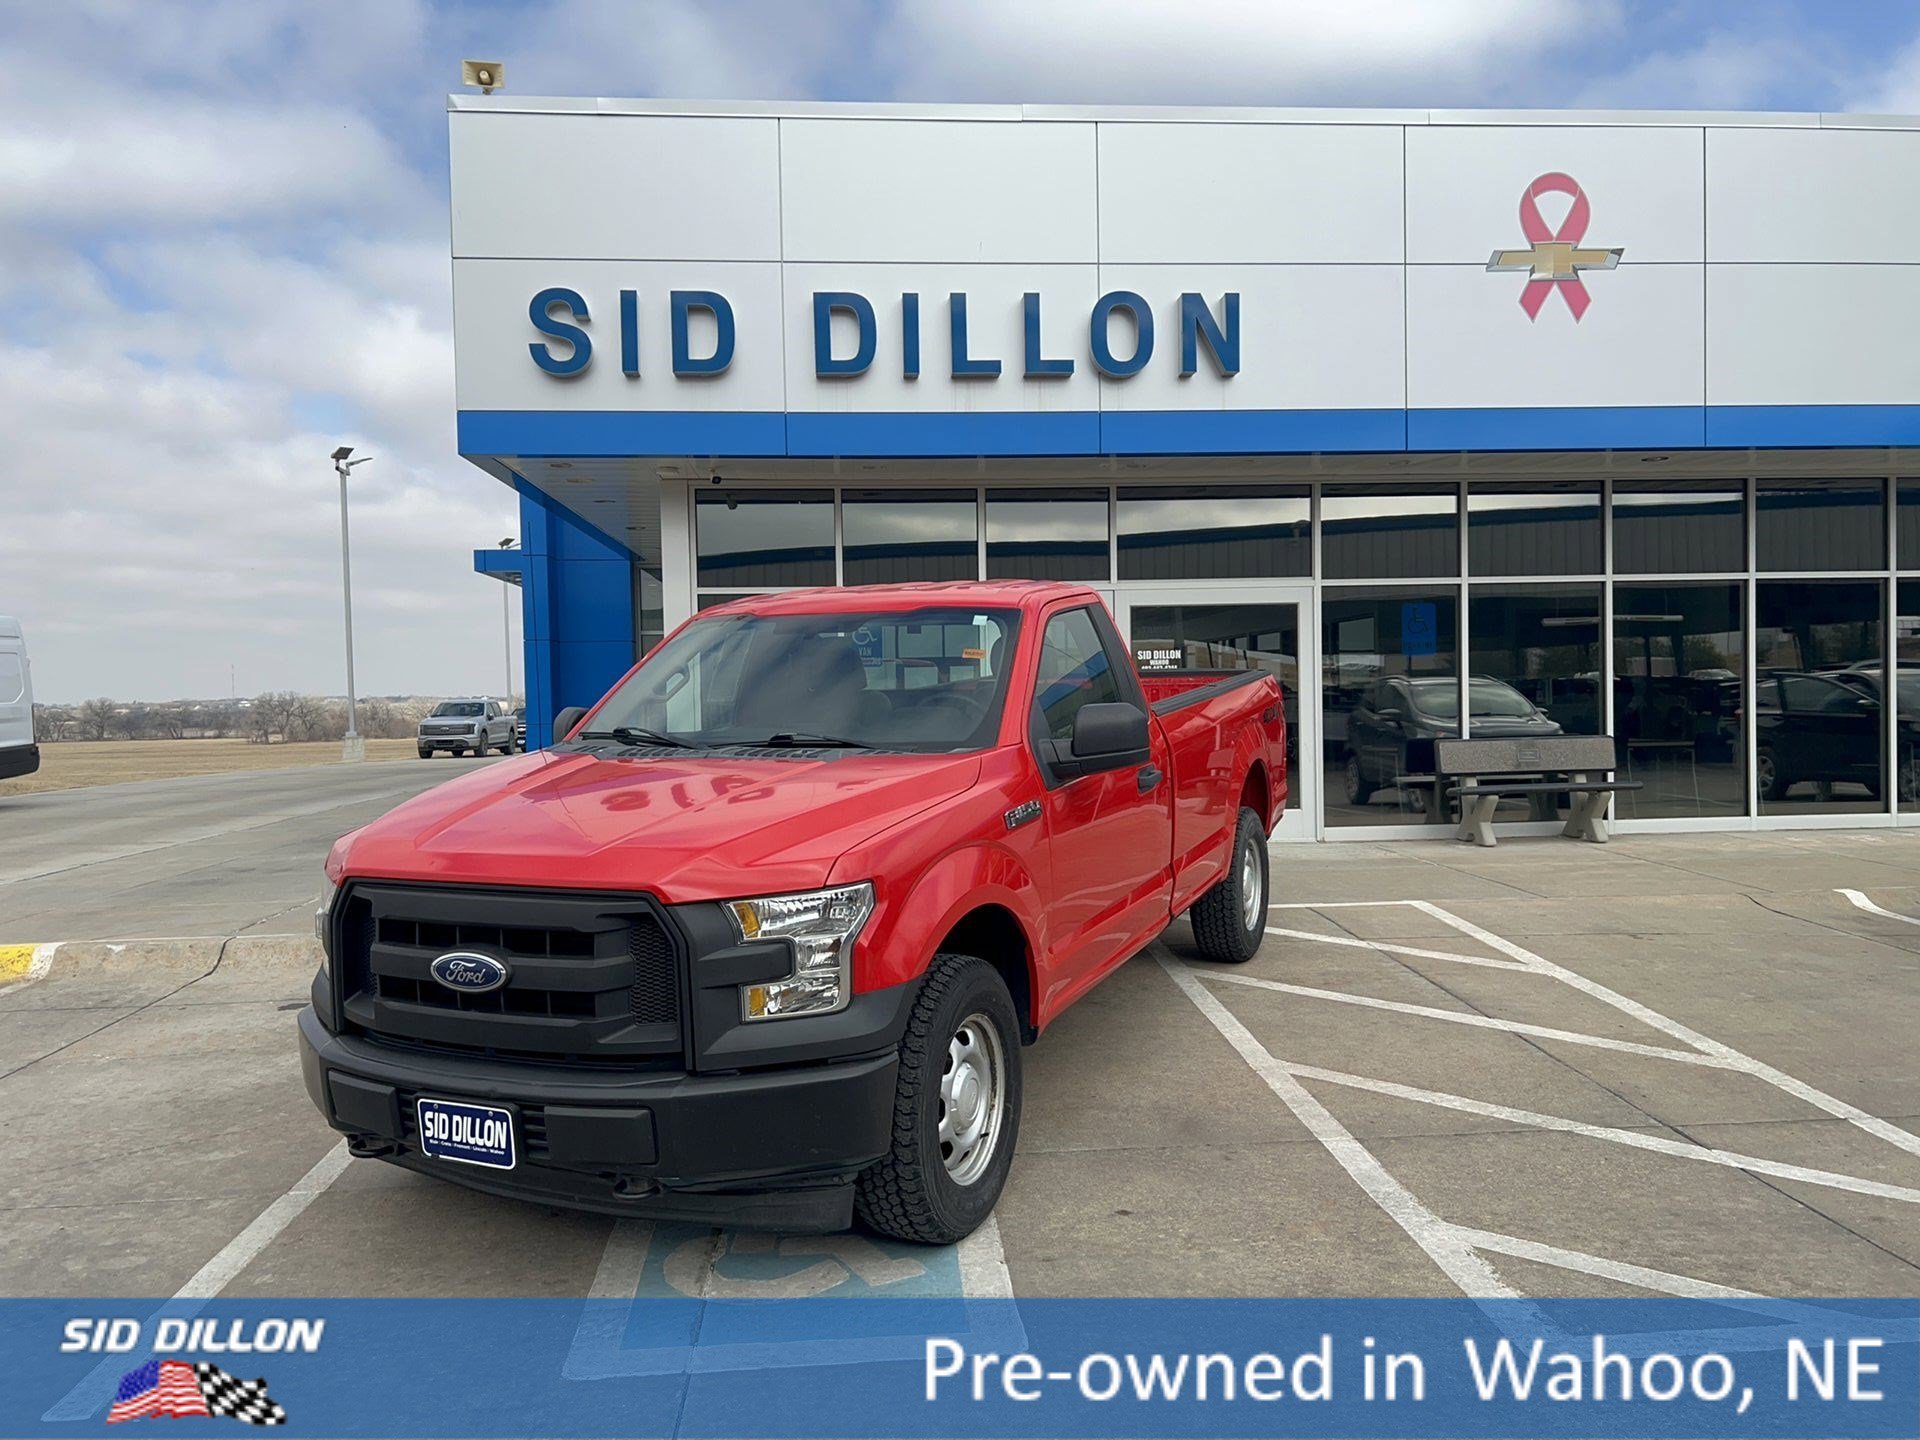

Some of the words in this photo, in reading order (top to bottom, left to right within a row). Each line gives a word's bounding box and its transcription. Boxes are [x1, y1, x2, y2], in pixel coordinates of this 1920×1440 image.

[528, 287, 736, 378] SID
[813, 290, 1241, 379] DILLON
[858, 646, 873, 657] VAN
[1137, 650, 1152, 660] SID
[1153, 649, 1181, 660] DILLON
[446, 960, 486, 984] Ford
[424, 1111, 449, 1140] SID
[452, 1114, 507, 1149] DILLON
